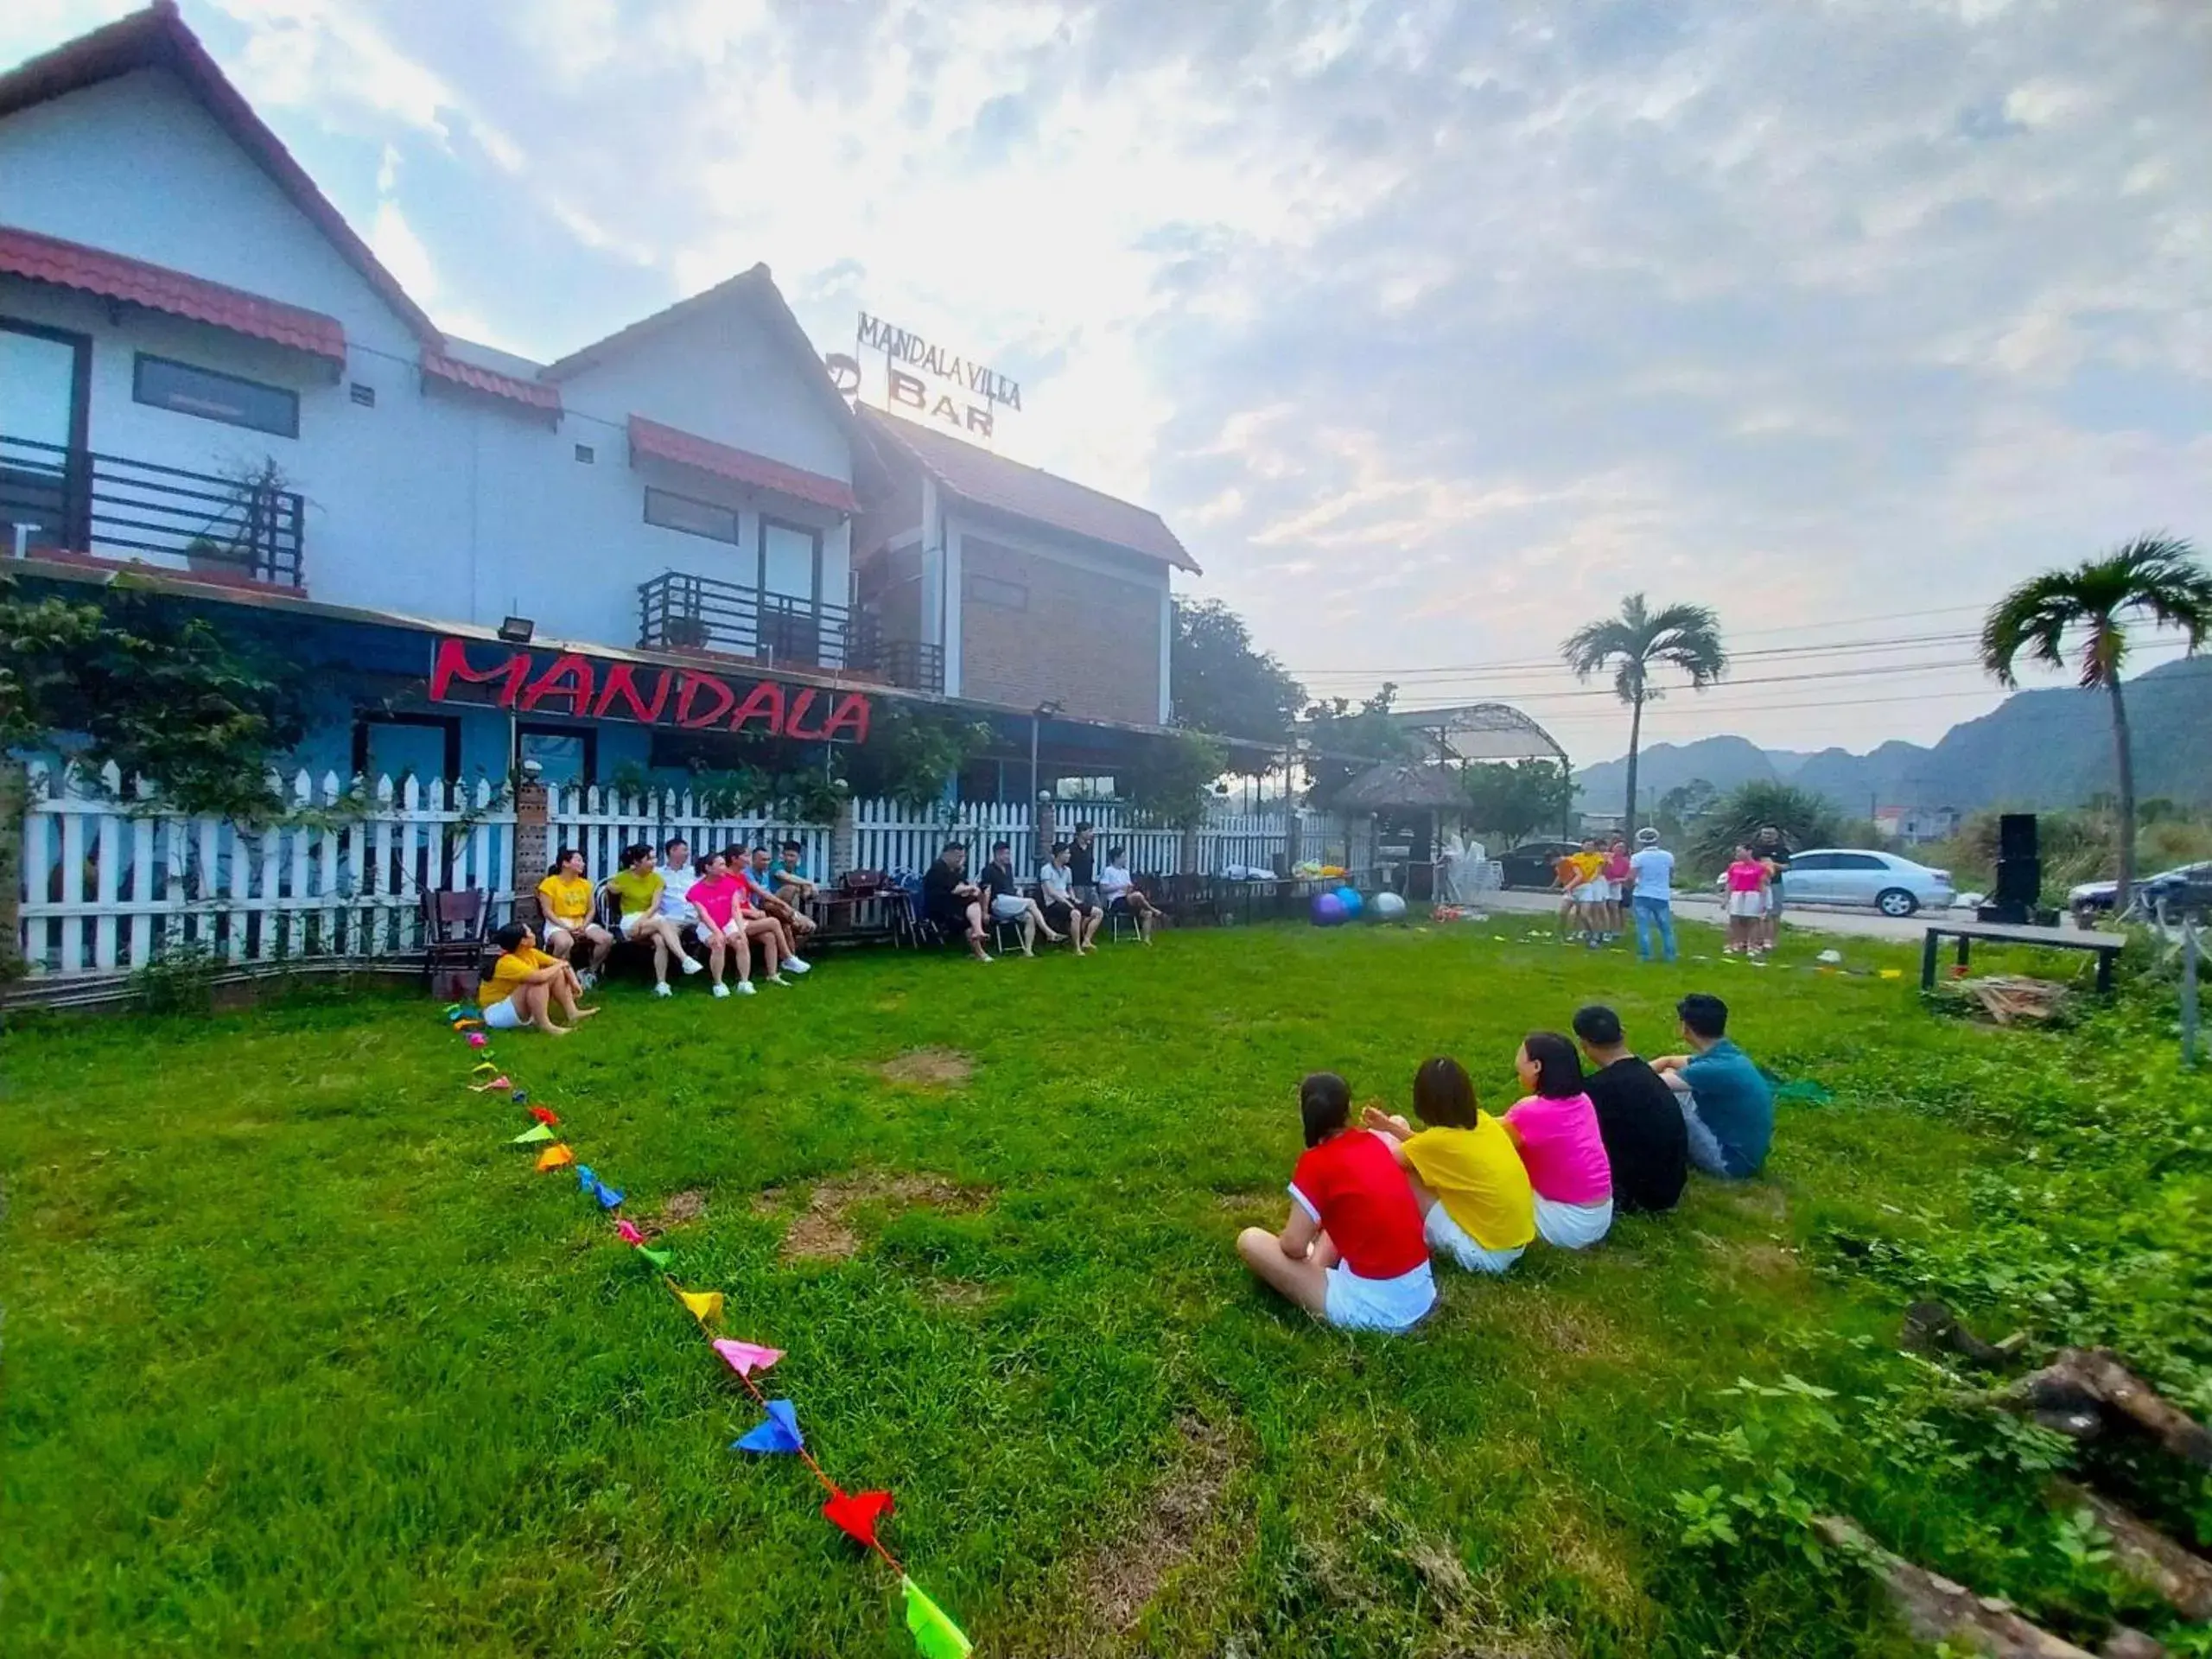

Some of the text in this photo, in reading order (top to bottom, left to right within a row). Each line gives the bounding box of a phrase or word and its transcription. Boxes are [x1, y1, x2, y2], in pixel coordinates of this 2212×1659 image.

[858, 311, 963, 385] MANDALA
[890, 368, 994, 439] BAR
[429, 639, 871, 744] MANDALA
